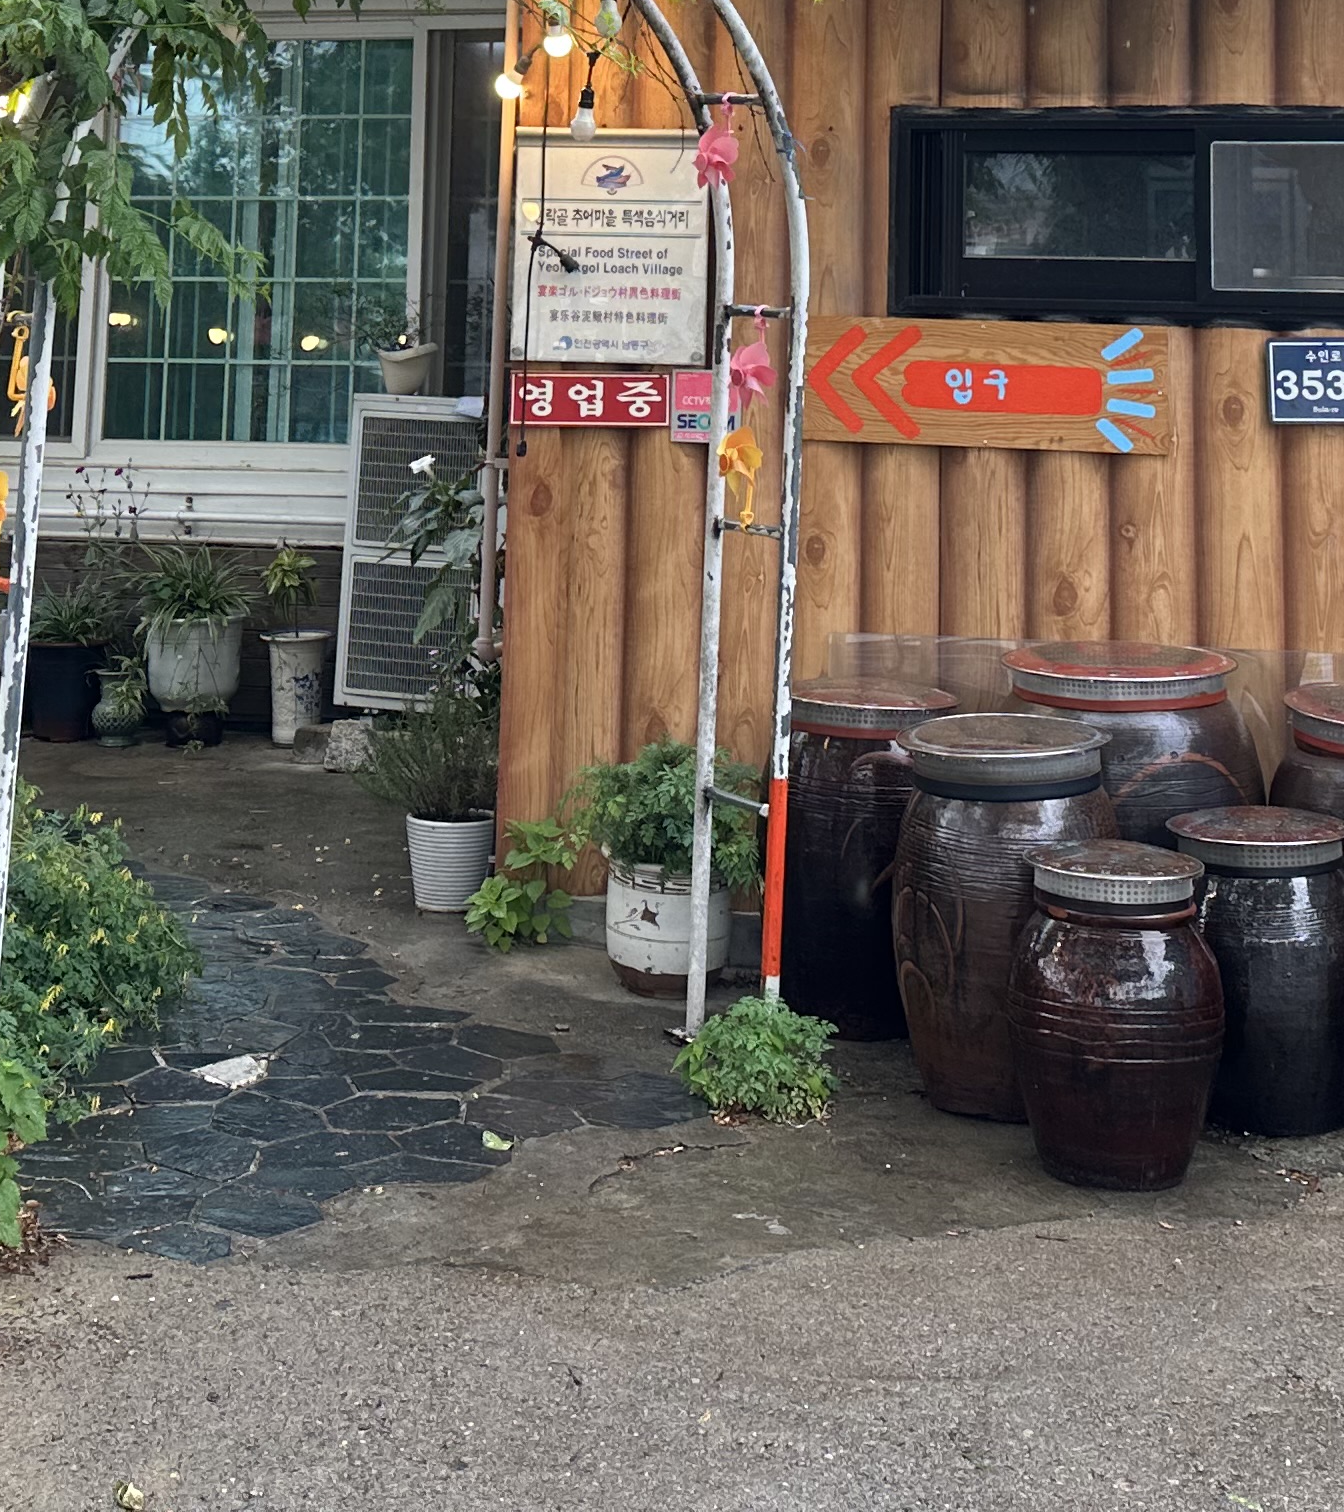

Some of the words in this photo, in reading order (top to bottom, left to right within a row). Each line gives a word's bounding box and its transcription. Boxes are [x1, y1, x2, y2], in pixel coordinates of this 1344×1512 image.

[571, 208, 618, 228] 추어마을
[621, 209, 689, 230] 특색음식거리
[585, 246, 614, 258] Food
[617, 247, 653, 259] Street
[656, 247, 668, 259] of
[603, 262, 639, 274] Loach
[642, 263, 683, 277] Village
[1305, 350, 1342, 363] 수인로
[945, 368, 1009, 405] 입구
[518, 379, 662, 418] 영업중
